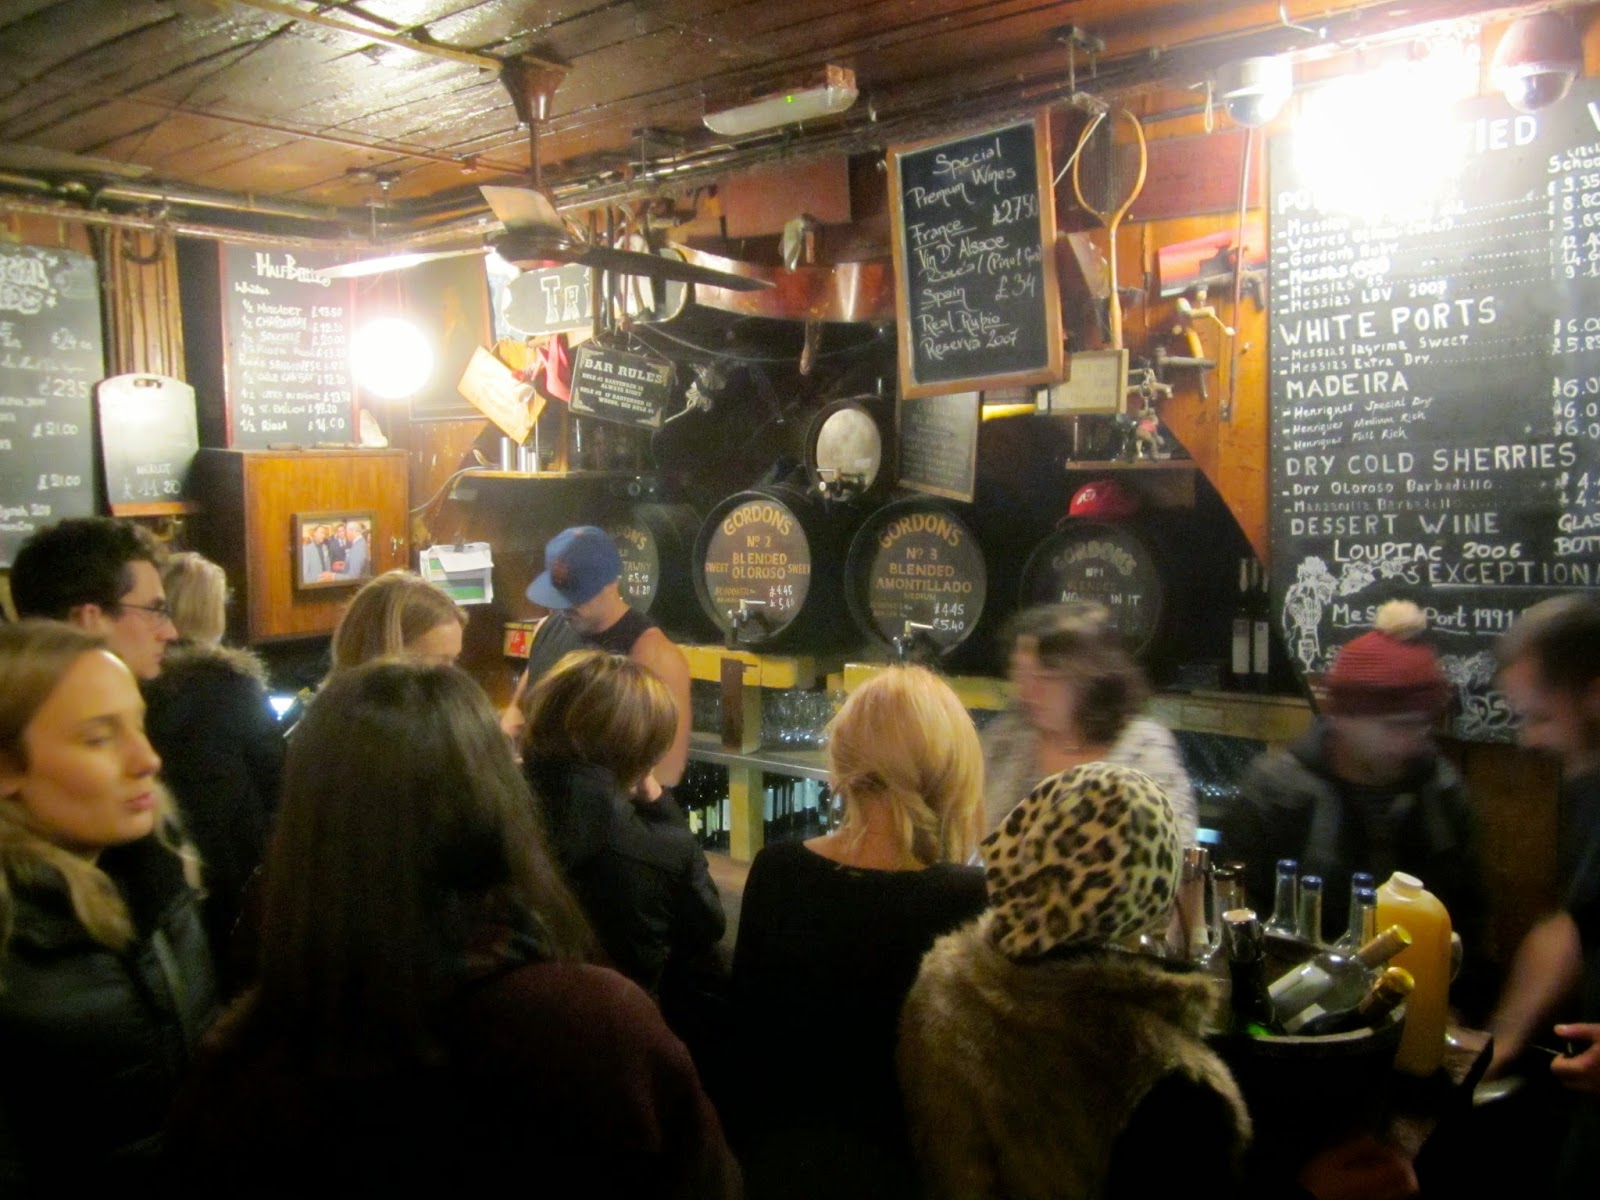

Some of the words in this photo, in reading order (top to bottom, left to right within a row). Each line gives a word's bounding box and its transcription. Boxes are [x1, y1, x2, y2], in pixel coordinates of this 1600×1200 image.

[1475, 115, 1537, 153] IED
[933, 138, 1001, 179] Special
[1547, 155, 1600, 173] Schoo
[972, 164, 1016, 194] Wines
[1278, 189, 1316, 214] PO
[908, 219, 964, 246] France
[922, 286, 978, 312] Spain
[1292, 294, 1351, 312] Messias
[1361, 288, 1392, 304] LBV
[916, 310, 955, 337] Real
[956, 311, 1000, 337] Rubio
[1279, 312, 1376, 346] WHITE
[1391, 296, 1497, 334] PORTS
[920, 338, 980, 360] Reserva
[986, 328, 1019, 348] 2007
[1292, 346, 1345, 360] Messias
[584, 358, 614, 374] BAR
[618, 365, 663, 385] RULES
[1291, 360, 1347, 374] Messias
[1286, 371, 1409, 399] MADEIRA
[1294, 402, 1354, 421] Henriques
[1365, 398, 1406, 415] Special
[1292, 421, 1344, 436] Henriques
[1353, 416, 1395, 428] Medium
[1286, 455, 1336, 476] DRY
[1348, 452, 1414, 475] COLD
[1433, 442, 1577, 472] SHERRIES
[1293, 483, 1320, 496] Dry
[1291, 514, 1399, 536] DESSERT
[1419, 512, 1500, 534] WINE
[1557, 513, 1600, 532] GLAS
[764, 535, 771, 548] 2
[1462, 542, 1522, 560] 2006
[1554, 536, 1600, 556] BOTT
[732, 552, 787, 566] BLENDED
[888, 562, 955, 577] BLENDED
[732, 566, 786, 579] OLOROSO
[875, 578, 972, 593] AMONTILLADO
[1473, 608, 1514, 629] 1991
